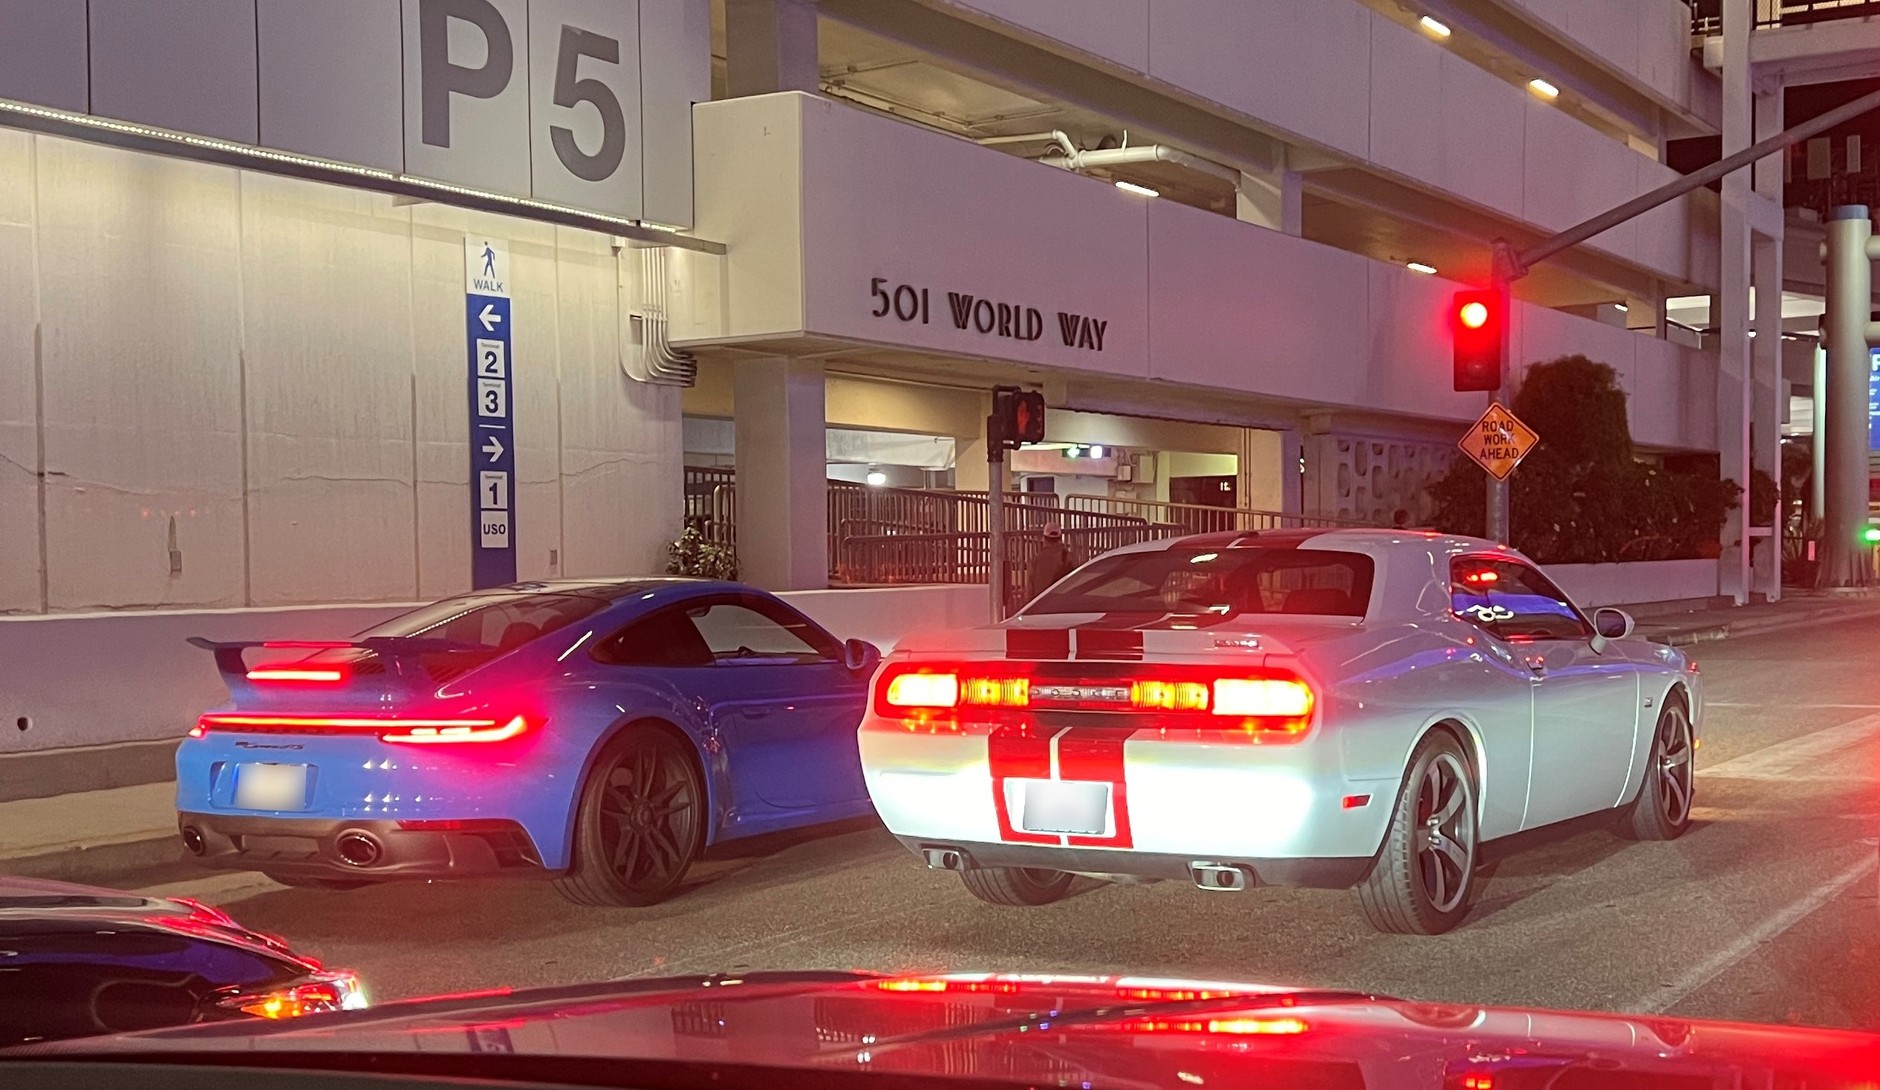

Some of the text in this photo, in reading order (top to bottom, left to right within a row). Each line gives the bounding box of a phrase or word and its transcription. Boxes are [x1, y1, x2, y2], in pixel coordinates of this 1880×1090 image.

[473, 278, 504, 293] WALK
[871, 277, 1108, 351] 501 WORLD WAY
[484, 350, 499, 374] 2
[484, 390, 499, 414] 3
[1482, 420, 1514, 432] ROAD
[1483, 433, 1515, 445] WORK
[1480, 447, 1519, 460] AHEAD
[488, 482, 498, 506] 1
[483, 523, 506, 535] USO
